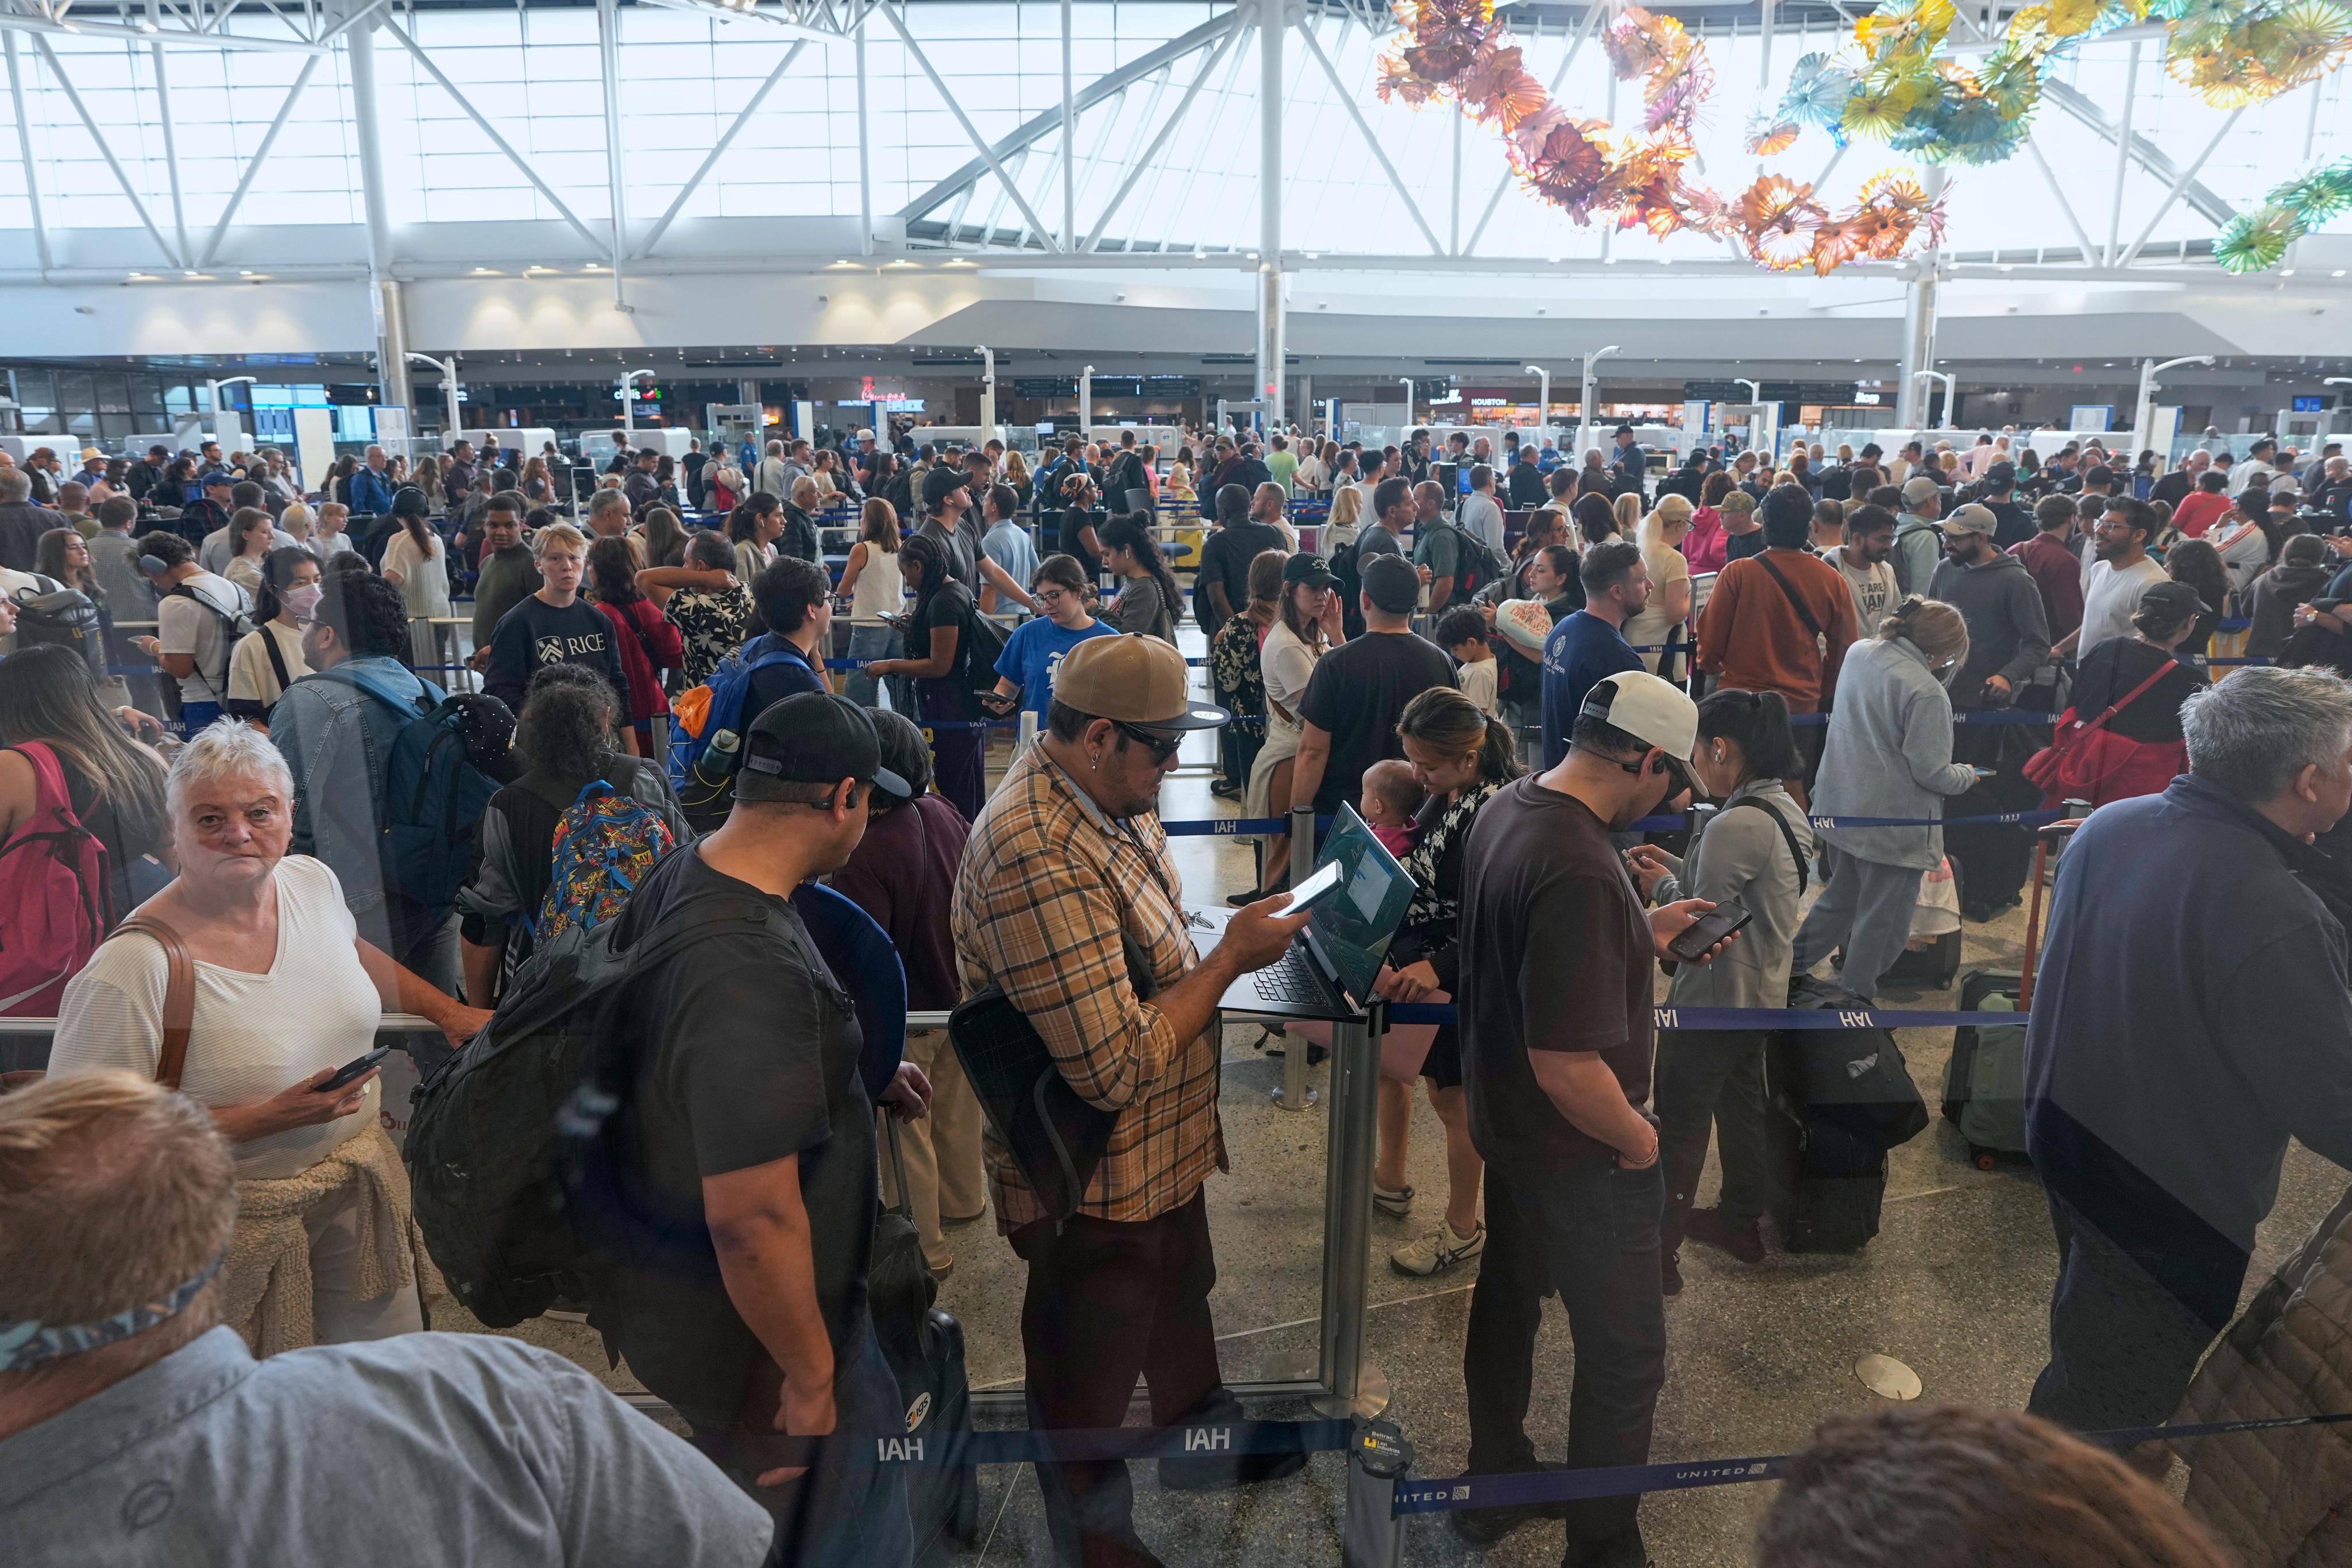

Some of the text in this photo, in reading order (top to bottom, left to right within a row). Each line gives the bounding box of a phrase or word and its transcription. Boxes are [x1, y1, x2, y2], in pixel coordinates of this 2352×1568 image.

[1867, 583, 1884, 593] ARE
[566, 633, 605, 655] RICE
[1197, 658, 1211, 666] IAH
[1952, 713, 1966, 723] AH
[169, 722, 186, 732] IAH
[1214, 821, 1236, 833] IAH
[1813, 817, 1836, 828] IAH
[1839, 1011, 1874, 1027] IAH
[1185, 1428, 1230, 1451] IAH
[1372, 1431, 1393, 1440] Beltrac
[878, 1438, 924, 1461] IAH
[1377, 1445, 1400, 1454] Industries
[1676, 1467, 1744, 1479] UNITED
[1394, 1492, 1447, 1503] ITED
